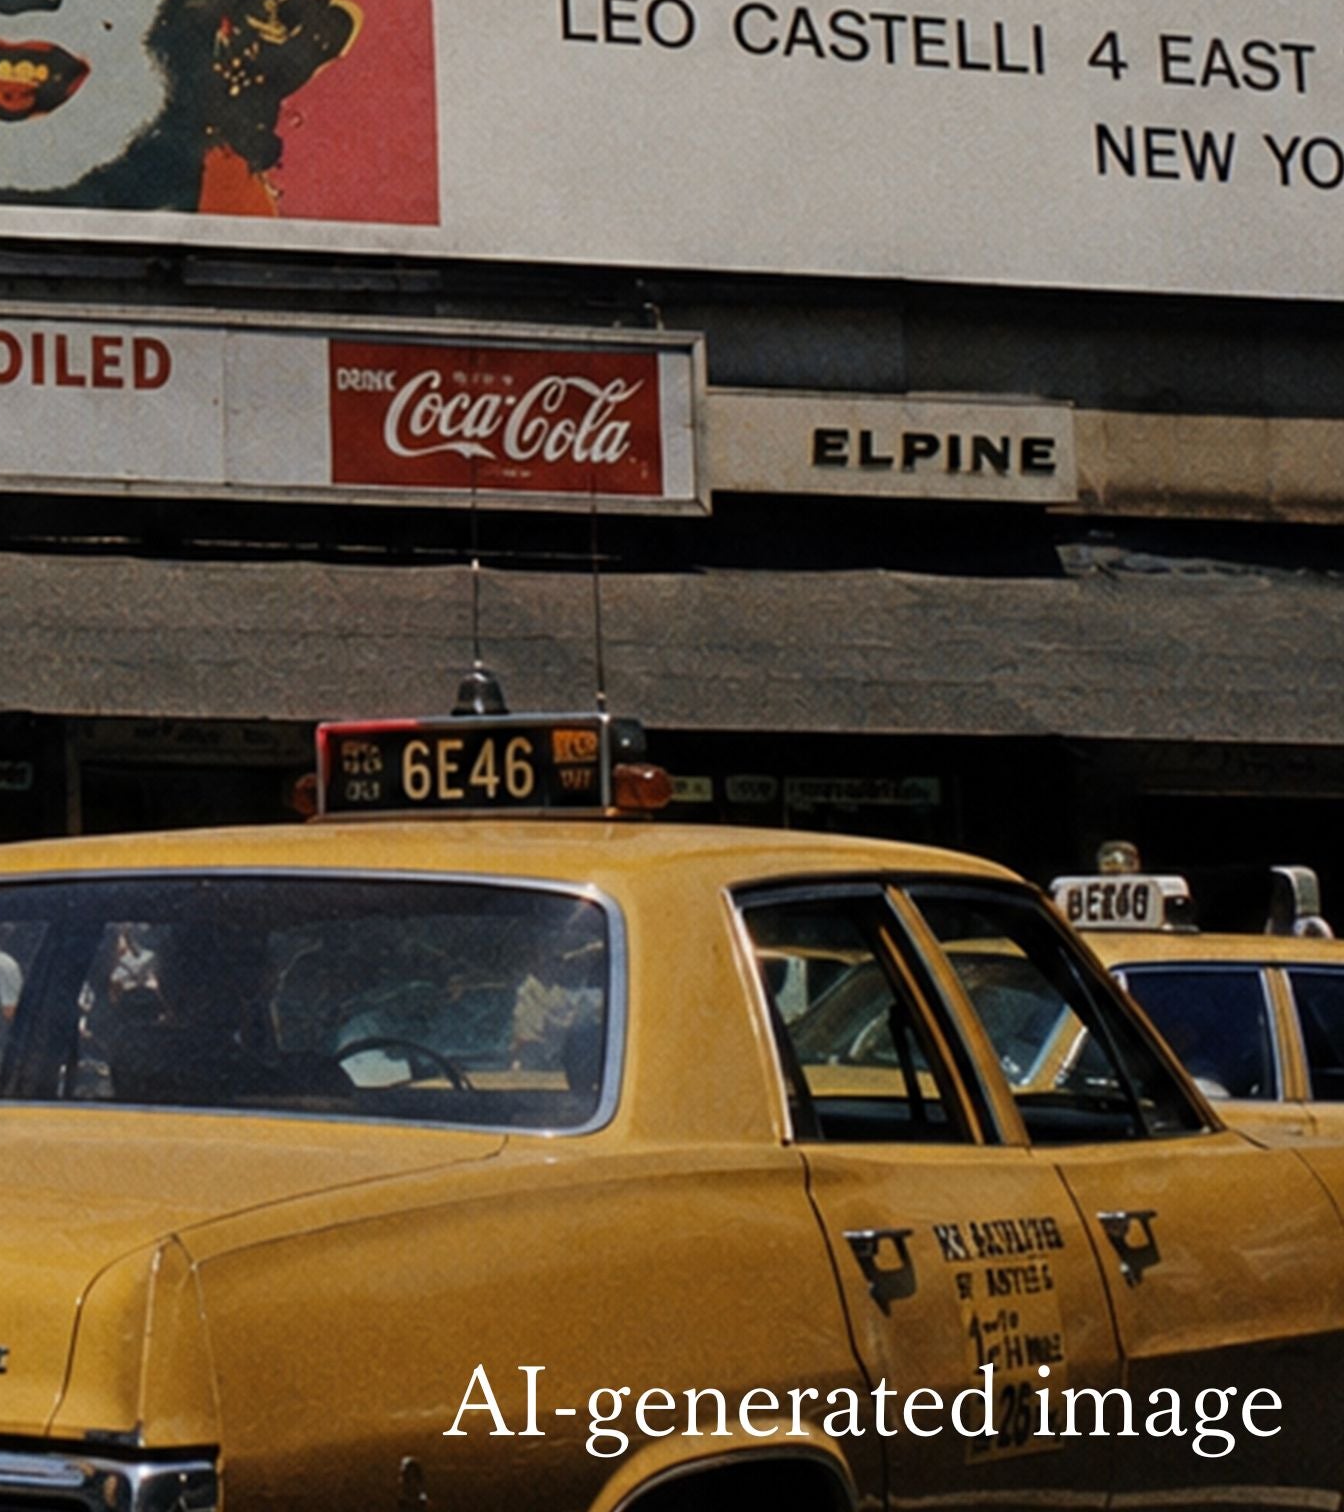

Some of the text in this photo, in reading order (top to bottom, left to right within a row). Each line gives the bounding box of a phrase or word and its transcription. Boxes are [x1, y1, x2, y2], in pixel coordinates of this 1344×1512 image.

[733, 1, 1046, 75] CASTELLI
[1087, 31, 1129, 81] 4
[1160, 35, 1316, 94] EAST
[1094, 123, 1344, 190] NEW YO
[383, 369, 645, 462] Coca-Cola
[812, 426, 1058, 476] ELPINE
[401, 736, 535, 800] 6E46
